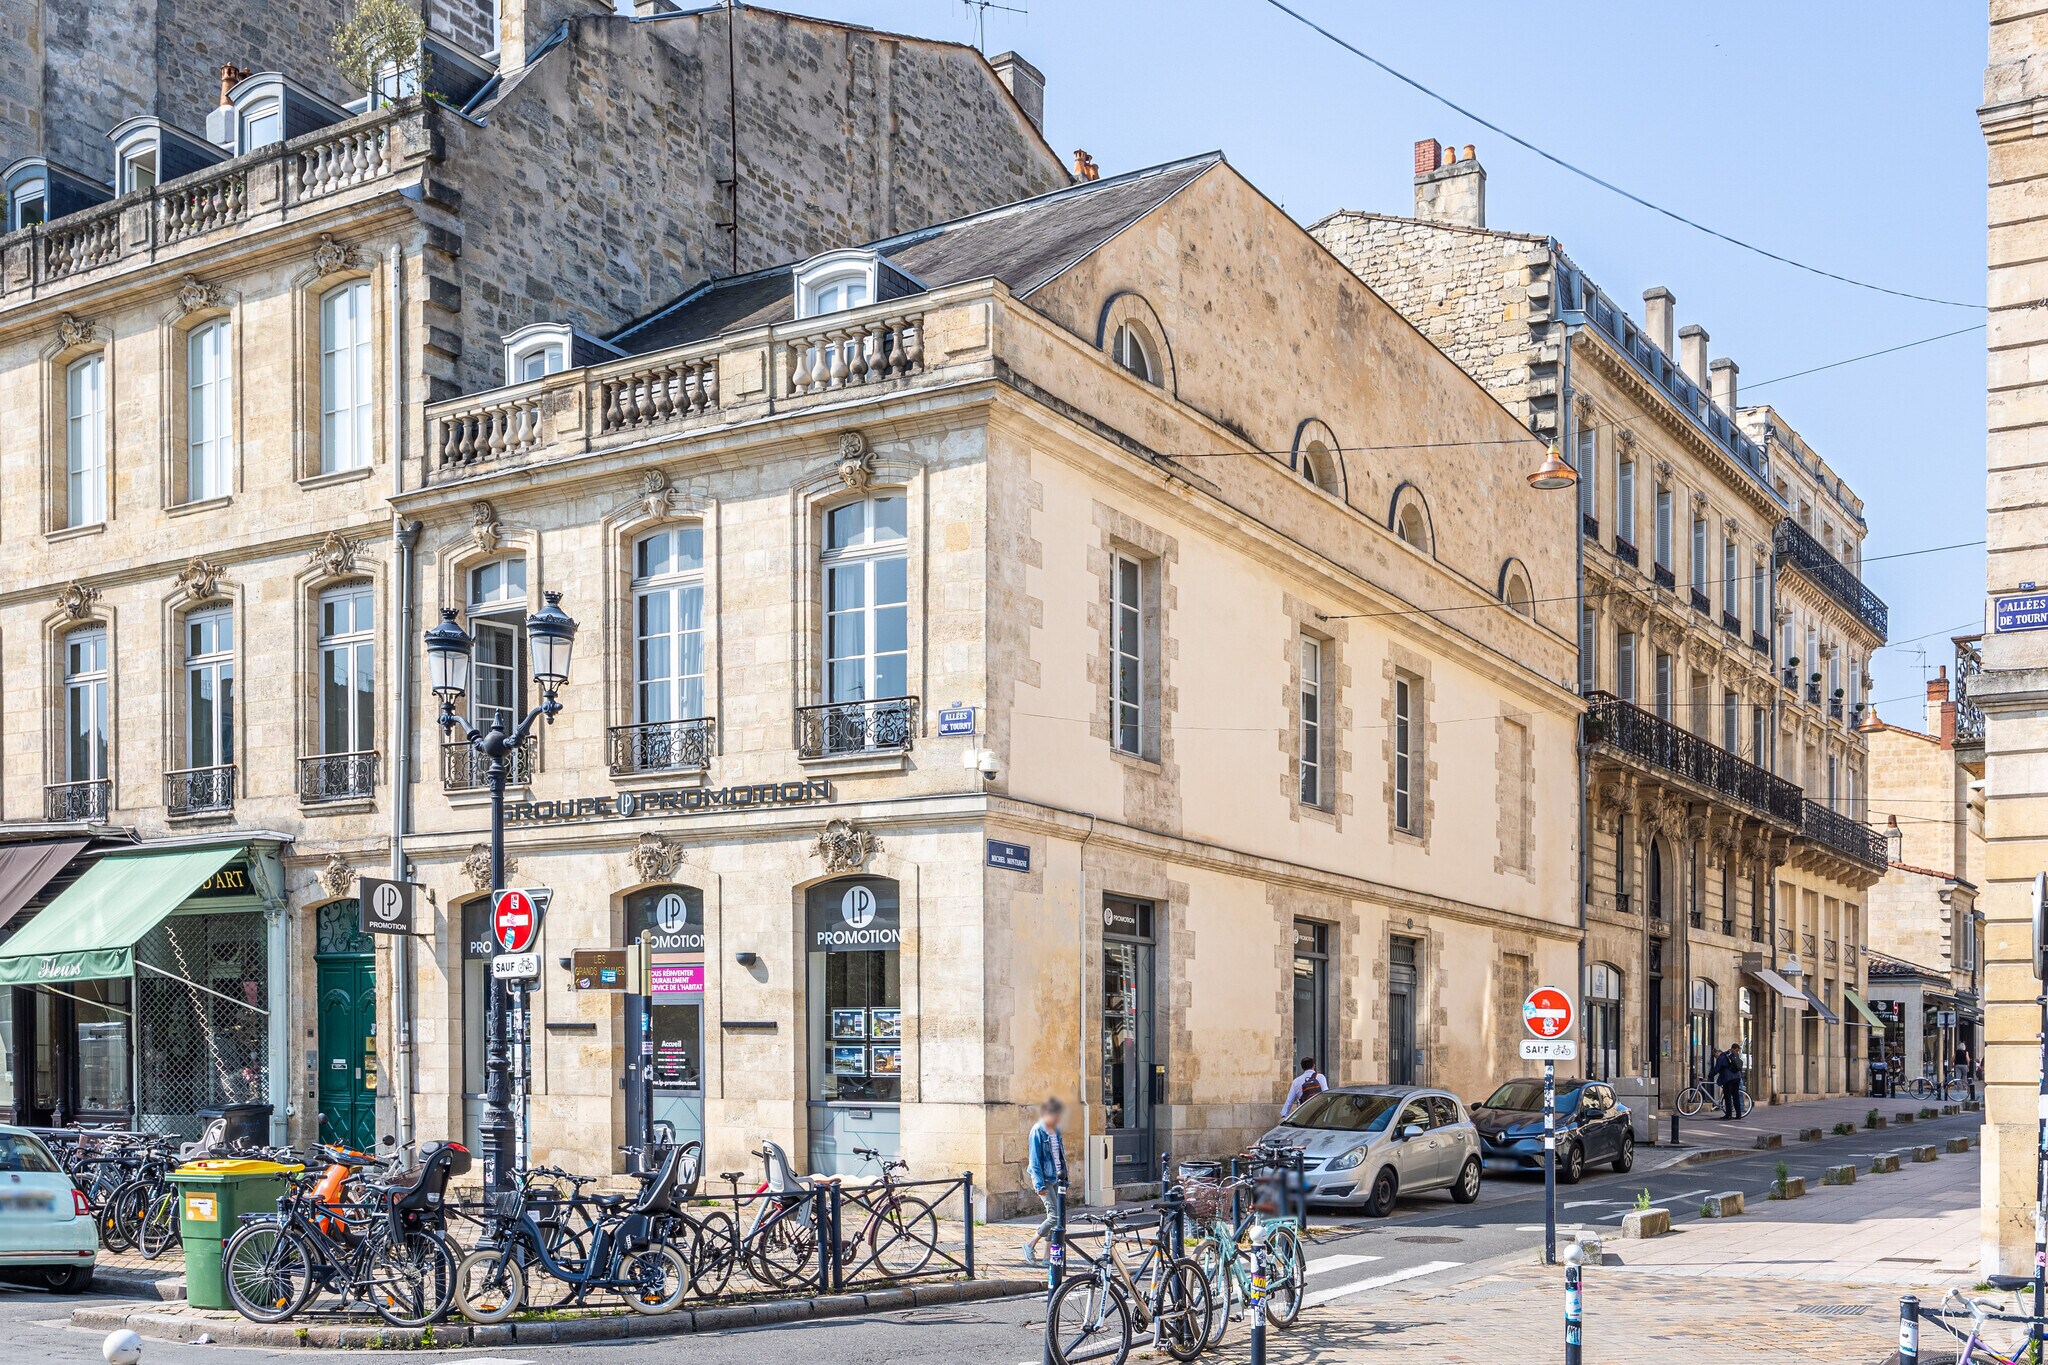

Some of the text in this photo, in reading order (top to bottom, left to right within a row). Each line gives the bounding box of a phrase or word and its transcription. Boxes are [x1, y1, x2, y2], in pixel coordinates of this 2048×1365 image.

[2006, 599, 2046, 612] ALLÉES
[1999, 612, 2048, 626] DE TOURN
[944, 712, 968, 721] ALLÉES
[941, 722, 971, 731] DE TOURNY
[639, 779, 830, 811] PROMOTION
[1005, 847, 1014, 855] RUE
[369, 921, 407, 931] PROMOTION
[817, 928, 901, 946] PROMOTION
[593, 954, 606, 964] LES
[37, 957, 81, 979] Fleurs
[496, 962, 515, 972] SAUF
[575, 966, 598, 976] GRANDS
[662, 968, 694, 977] RÉINVENTER
[652, 976, 690, 984] DURABLEMENT
[677, 983, 703, 991] L'HABITAT
[661, 1040, 682, 1048] Accueil
